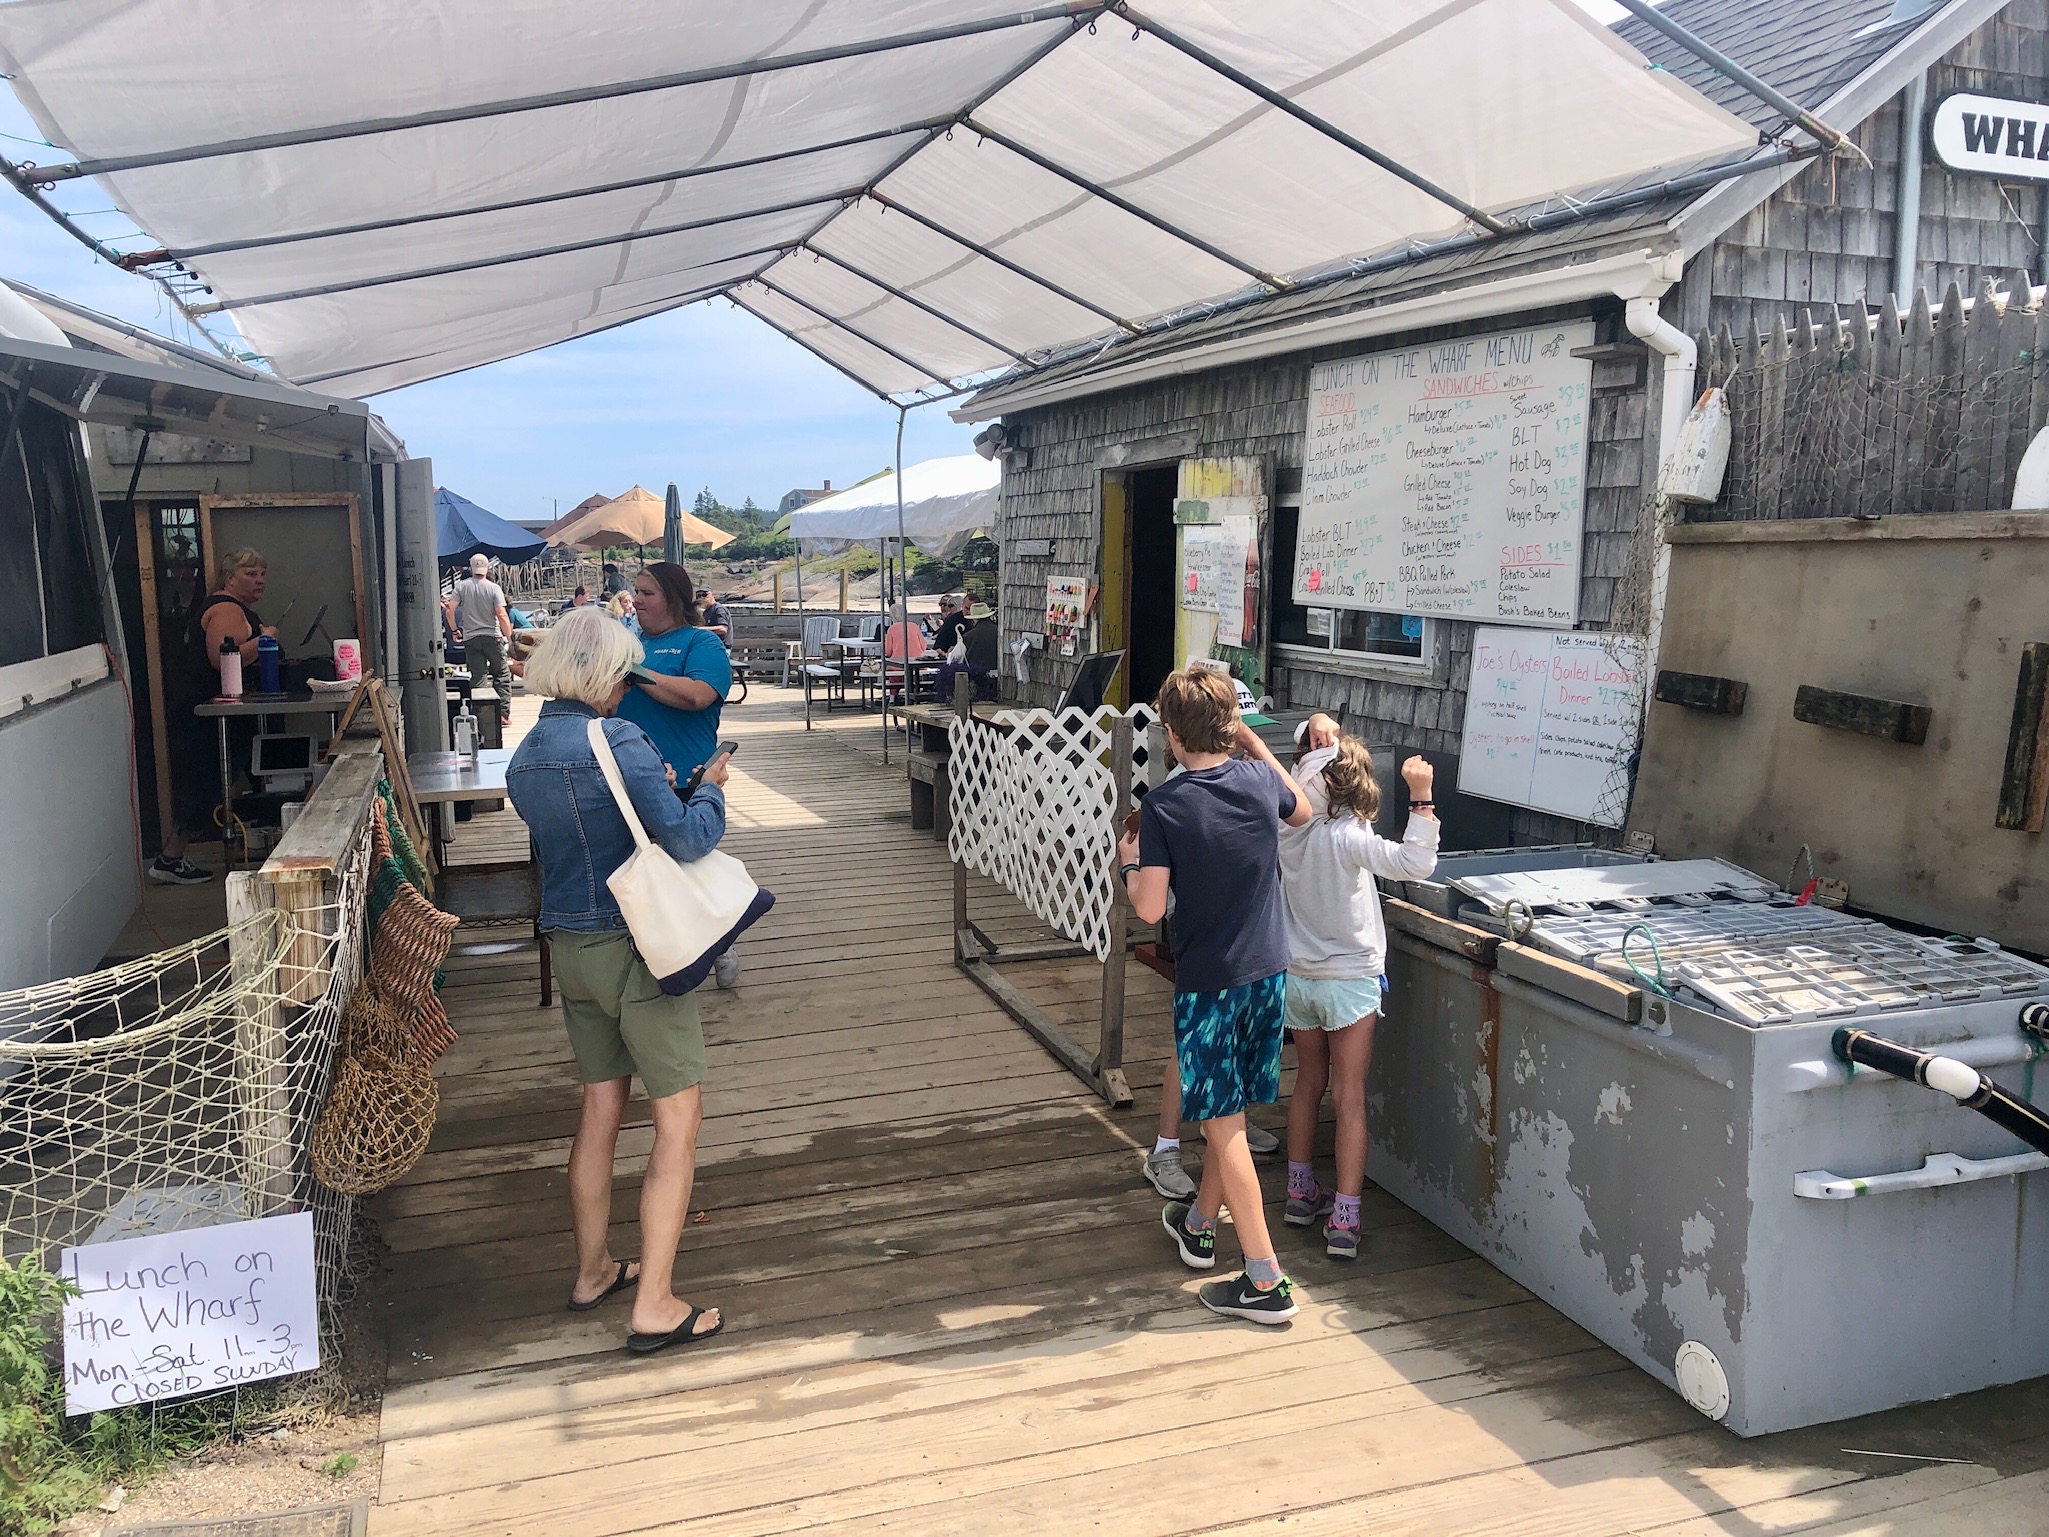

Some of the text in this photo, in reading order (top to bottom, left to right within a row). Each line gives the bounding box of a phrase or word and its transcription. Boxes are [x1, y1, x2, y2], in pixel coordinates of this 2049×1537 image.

[1313, 333, 1534, 391] LUNCH ON THE WHARF MENU
[1423, 371, 1498, 398] SANDWICHES
[1320, 392, 1356, 414] SEAFOOD
[1514, 401, 1557, 420] Sausage
[1408, 403, 1452, 425] Hamburger
[1310, 419, 1339, 440] Lobster
[1342, 413, 1357, 433] Roll
[1511, 424, 1542, 447] BLT
[1308, 441, 1338, 461] Lobster
[1361, 432, 1381, 451] Cheese
[1406, 440, 1454, 460] Cheeseburger
[1307, 461, 1339, 484] Haddock
[1340, 459, 1369, 478] Chowder
[1509, 451, 1529, 473] Hot
[1534, 450, 1552, 475] Dog
[1404, 474, 1425, 492] Grilled
[1428, 473, 1451, 490] Cheese
[1508, 478, 1527, 499] Soy
[1530, 478, 1548, 502] Dog
[1326, 485, 1352, 504] Chowder
[1402, 516, 1420, 532] Steak
[1426, 516, 1449, 530] Cheese
[1506, 507, 1532, 528] Veggie
[1534, 504, 1560, 526] Burger
[1302, 527, 1330, 543] Lobster
[1333, 521, 1352, 541] BLT
[1300, 544, 1320, 561] Boiled
[1322, 543, 1334, 558] Lob
[1337, 543, 1358, 558] Dinner
[1402, 541, 1430, 557] Chicken
[1436, 538, 1461, 553] Cheese
[1500, 544, 1542, 565] SIDES
[1399, 564, 1456, 583] BBQ Pulled Pork
[1500, 567, 1550, 580] Potato Salad
[1336, 576, 1355, 597] Cheese
[1414, 584, 1442, 595] Sandwich
[1499, 581, 1530, 592] Coleslaw
[1432, 600, 1452, 611] Cheese
[1498, 592, 1518, 603] Chips
[1498, 604, 1571, 620] Bush's Baked Beans
[1556, 636, 1571, 646] Not
[1575, 638, 1597, 647] served
[1476, 646, 1548, 681] Joe's Oysters
[1553, 656, 1589, 681] Boiled
[1560, 685, 1592, 705] Dinner
[1543, 708, 1561, 720] Served
[73, 1251, 273, 1294] Lunch on
[73, 1277, 266, 1341] the Wharf
[214, 1352, 299, 1386] SUNDAY
